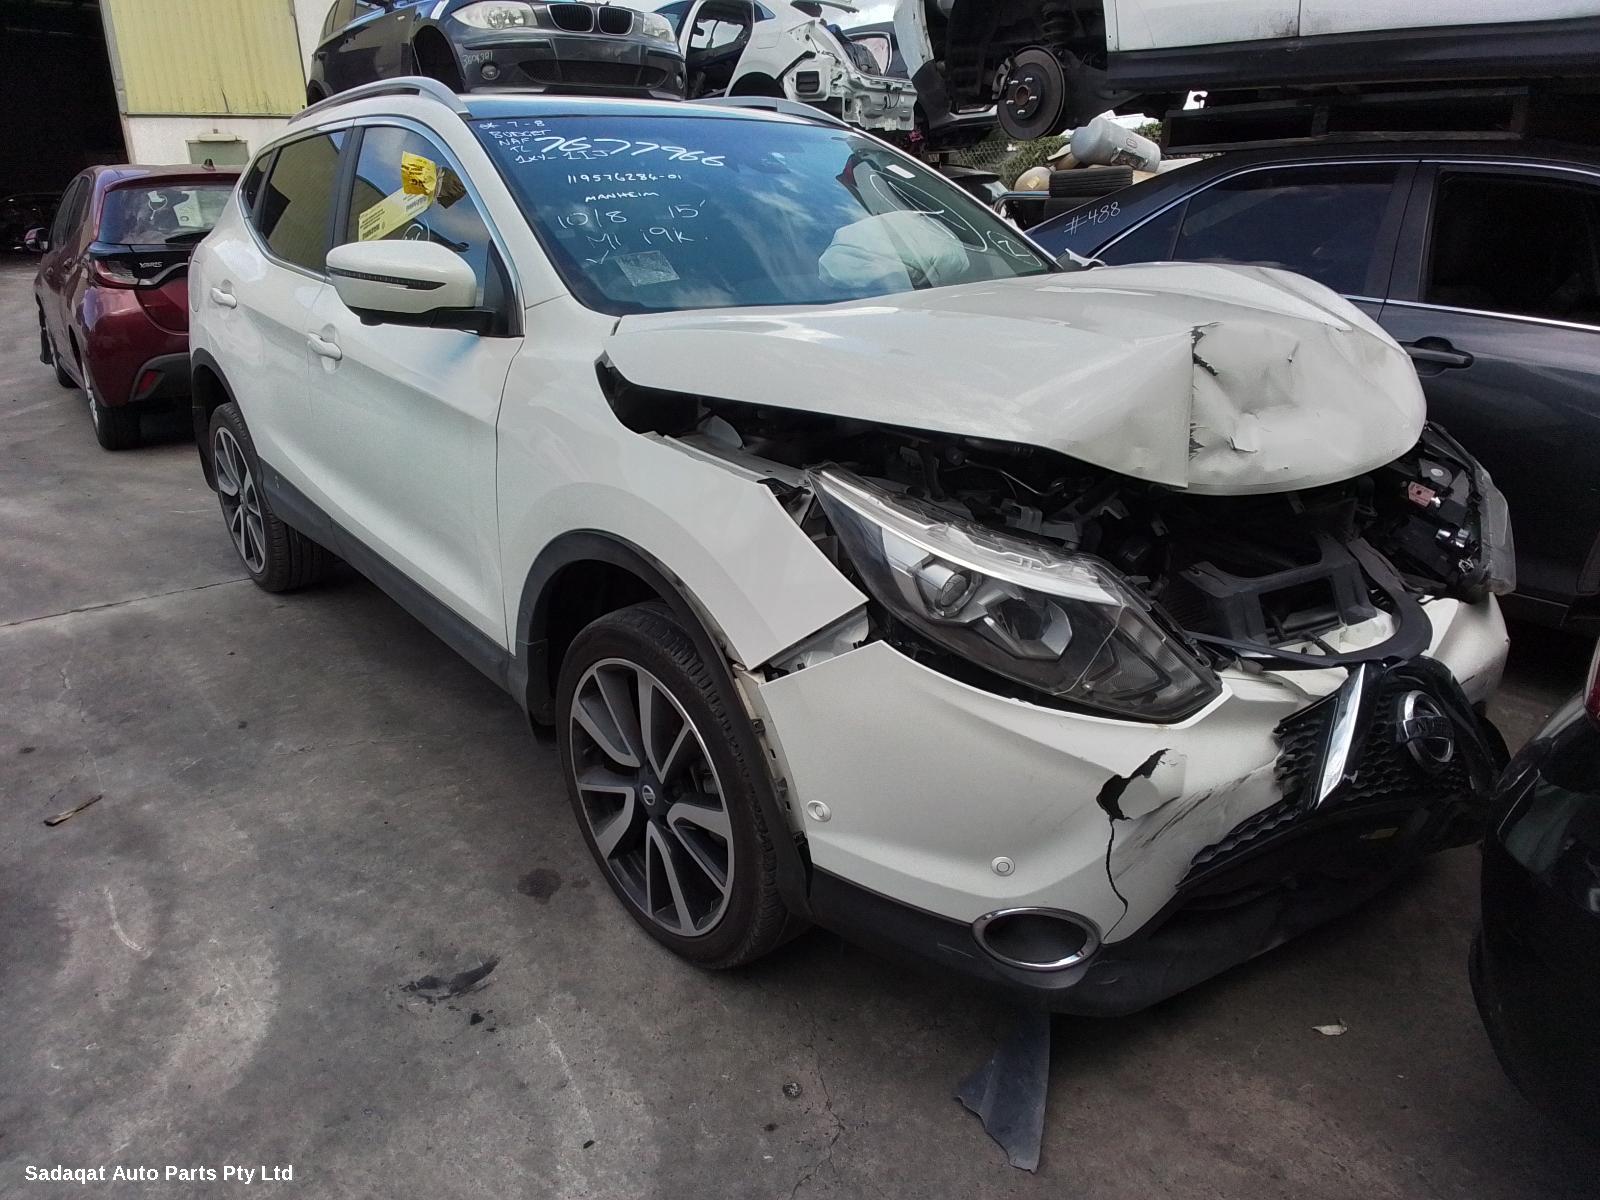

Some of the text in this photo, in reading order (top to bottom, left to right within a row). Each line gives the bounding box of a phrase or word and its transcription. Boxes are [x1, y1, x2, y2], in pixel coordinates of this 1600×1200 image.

[534, 136, 726, 166] 7677966
[567, 173, 682, 184] 119576284-01
[585, 191, 660, 203] MANHEIM
[1064, 202, 1121, 235] #488
